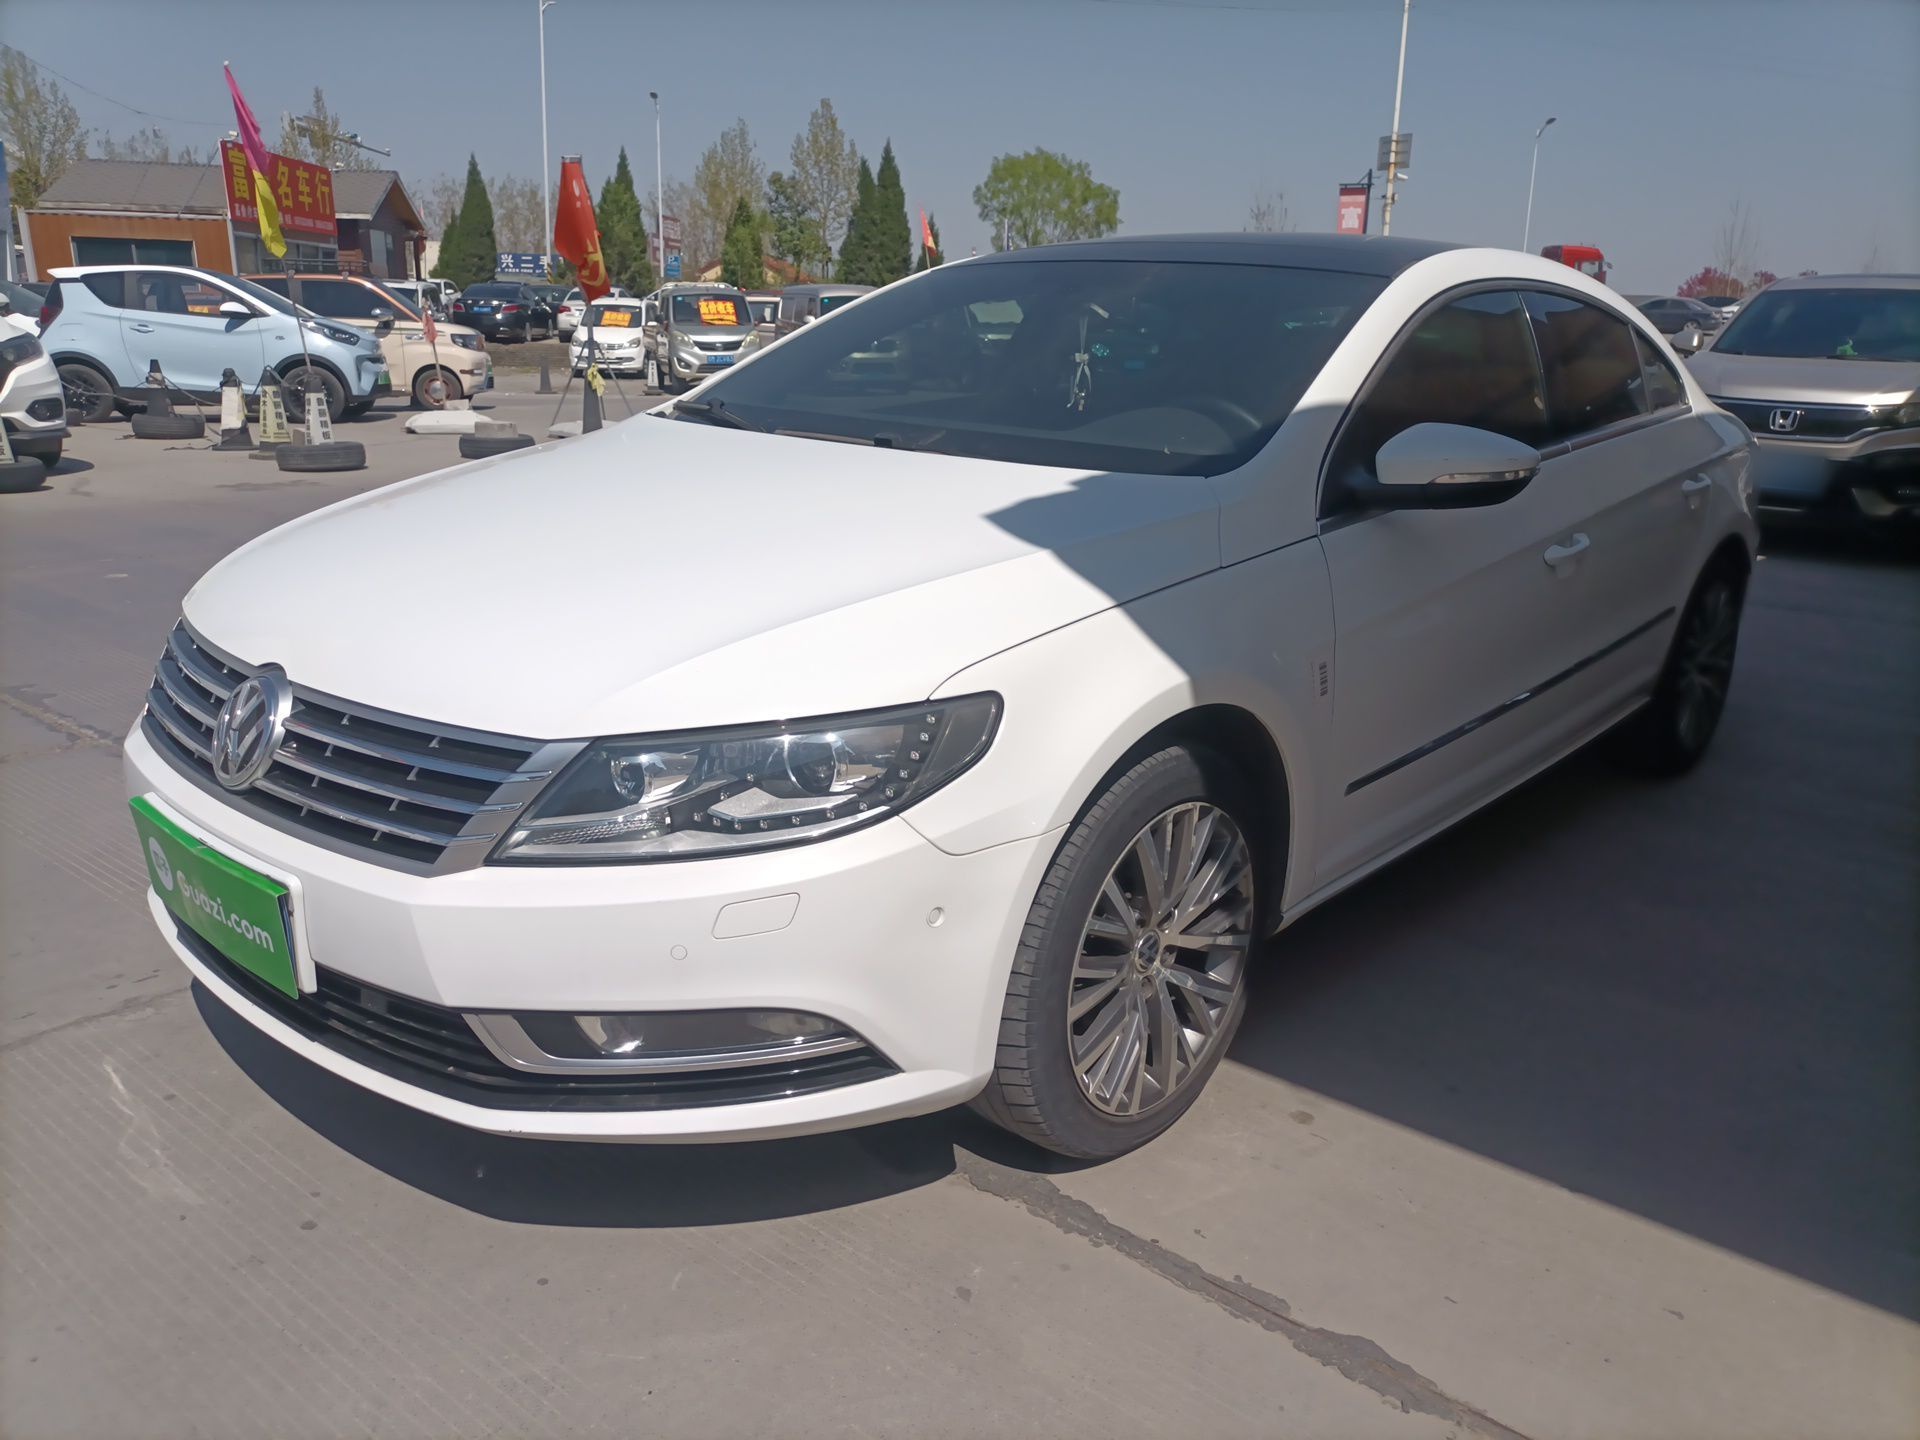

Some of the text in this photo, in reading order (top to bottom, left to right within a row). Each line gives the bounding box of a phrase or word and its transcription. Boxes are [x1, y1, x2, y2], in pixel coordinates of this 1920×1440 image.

[227, 147, 330, 216] 富名车行
[176, 869, 275, 953] Guazi.com
